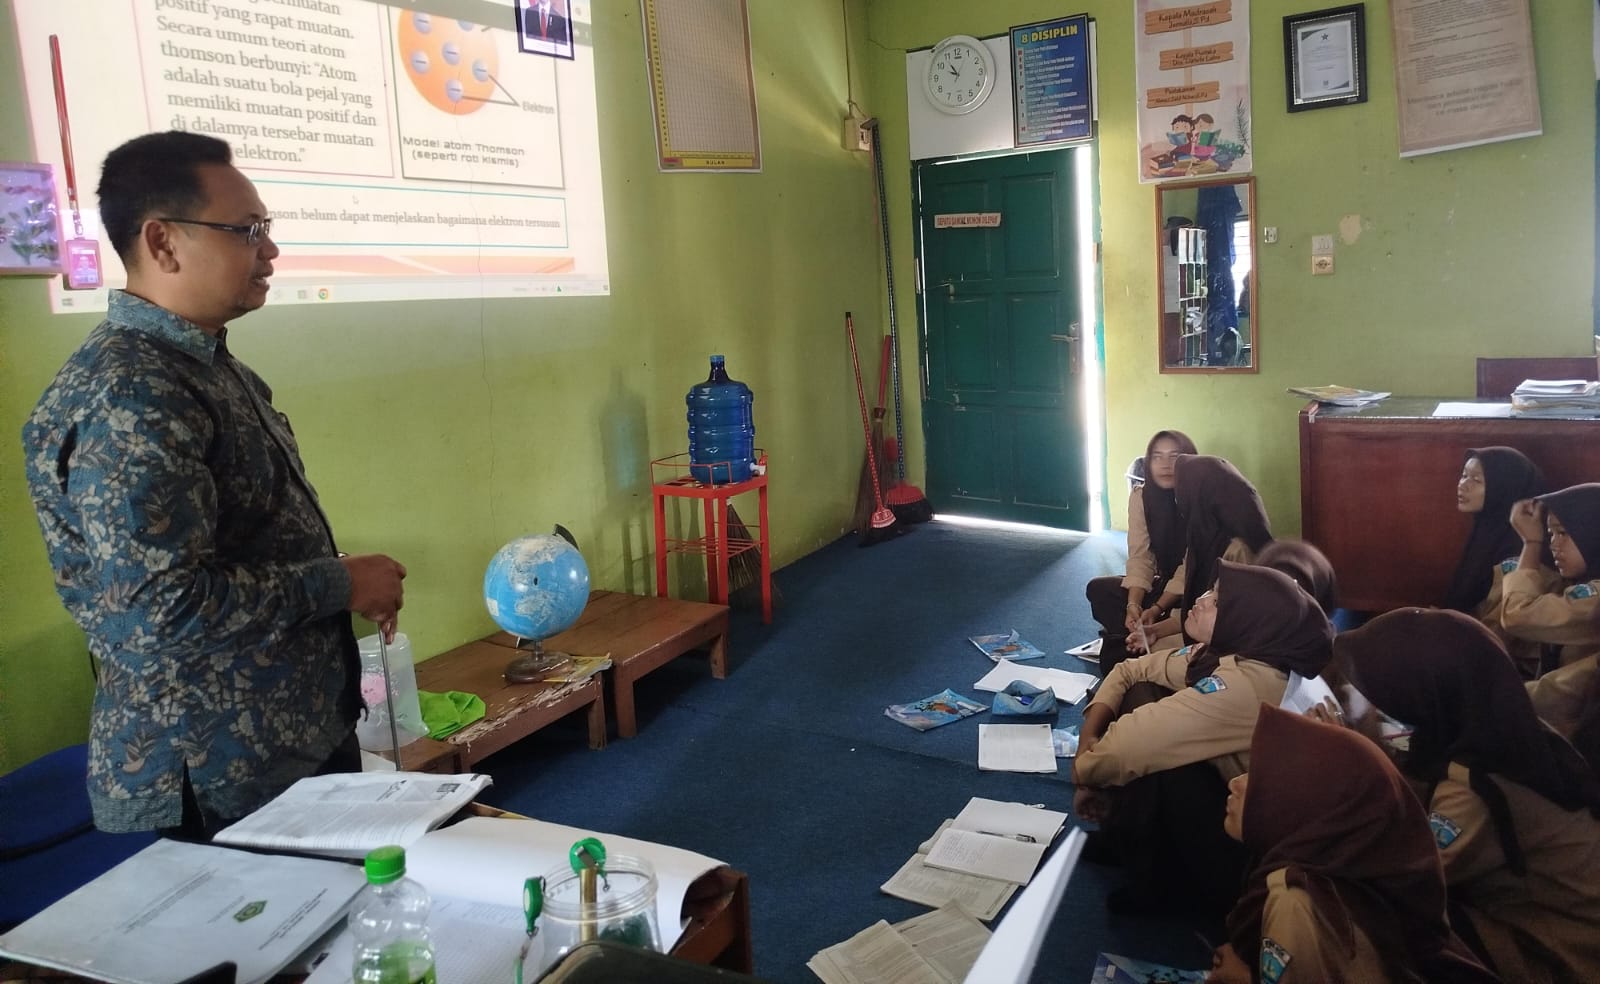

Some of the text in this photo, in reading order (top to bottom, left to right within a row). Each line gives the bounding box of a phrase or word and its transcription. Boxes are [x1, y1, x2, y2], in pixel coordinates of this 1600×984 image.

[155, 0, 354, 39] positif yang rapat muatan.
[1021, 24, 1078, 43] 8 DISIPLIN
[156, 15, 345, 58] Secara umum teori atom
[160, 40, 236, 65] thomson
[239, 50, 311, 77] berbunyi:
[163, 66, 373, 108] adalah suatu bola pejal yang
[168, 94, 377, 126] memiliki muatan positif dan
[522, 101, 555, 114] Elektron
[170, 114, 186, 131] di
[262, 125, 320, 142] tersebar
[323, 132, 374, 146] muatan
[403, 136, 525, 156] Model atom Thomson
[412, 150, 519, 168] (seperti roti kismis)
[301, 208, 337, 221] belum
[340, 209, 370, 224] dapat
[372, 211, 435, 224] menjelaskan
[437, 213, 487, 227] bagaimana
[488, 215, 524, 226] elektron
